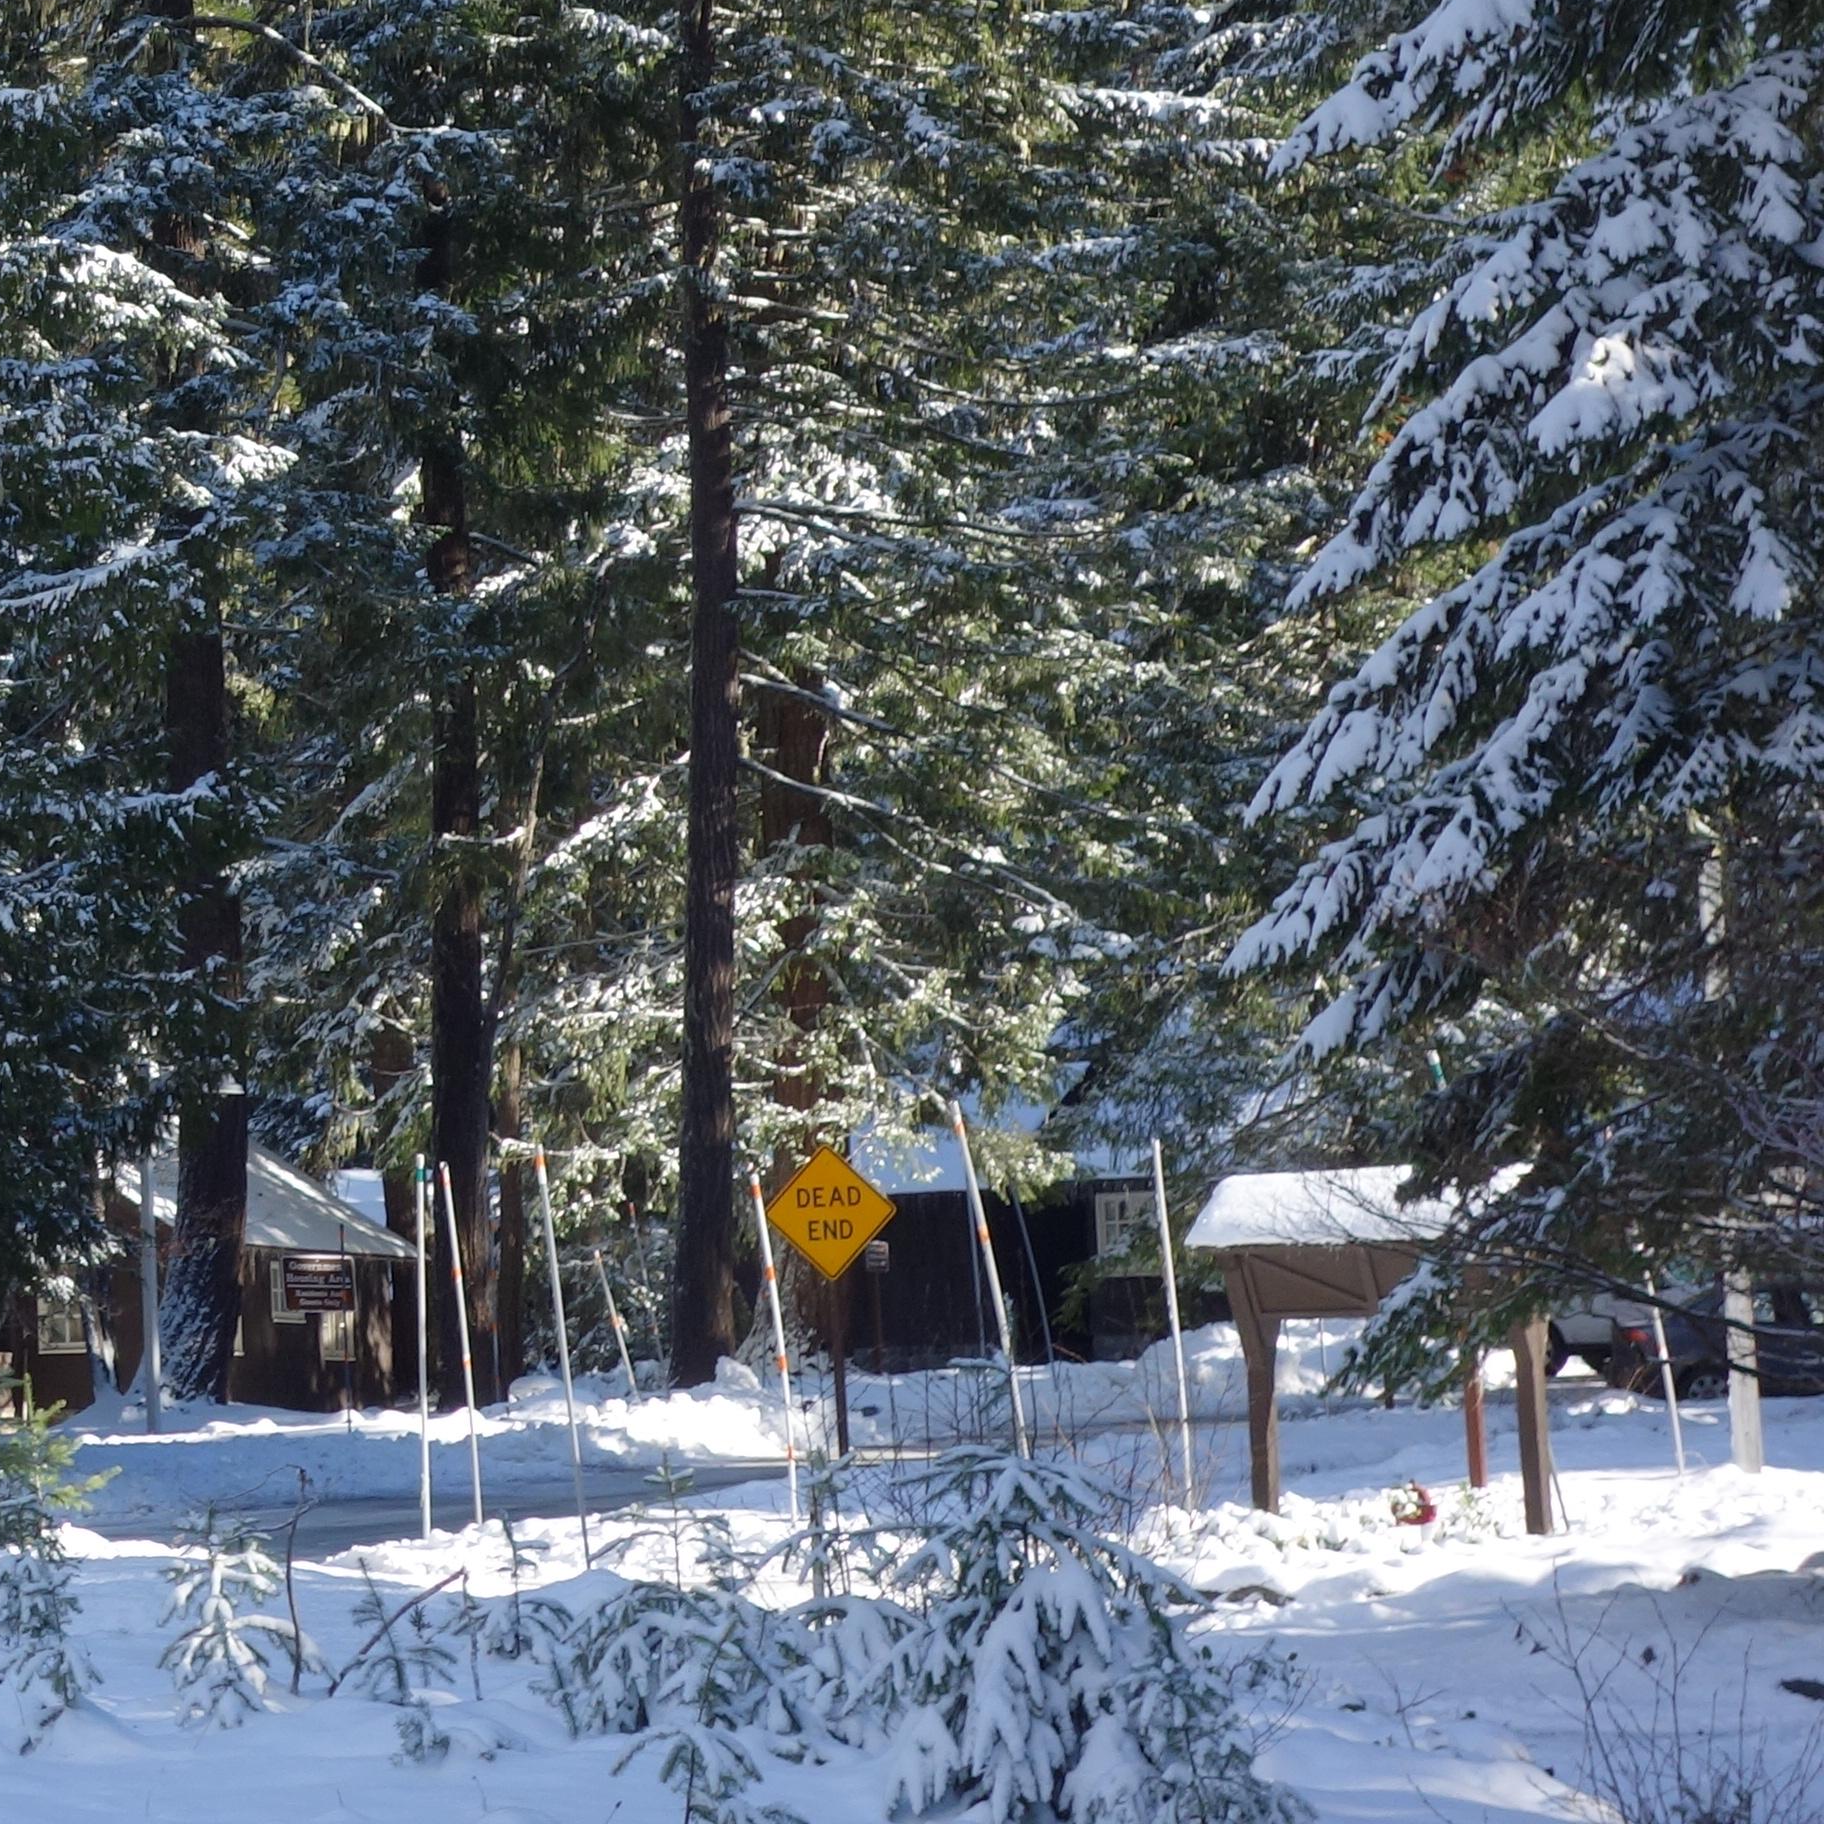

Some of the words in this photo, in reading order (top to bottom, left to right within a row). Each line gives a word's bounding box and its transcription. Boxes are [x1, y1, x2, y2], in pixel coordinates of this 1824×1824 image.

[796, 1186, 861, 1208] DEAD
[808, 1219, 854, 1241] END
[288, 1260, 344, 1272] Governmen
[328, 1274, 351, 1283] Ara
